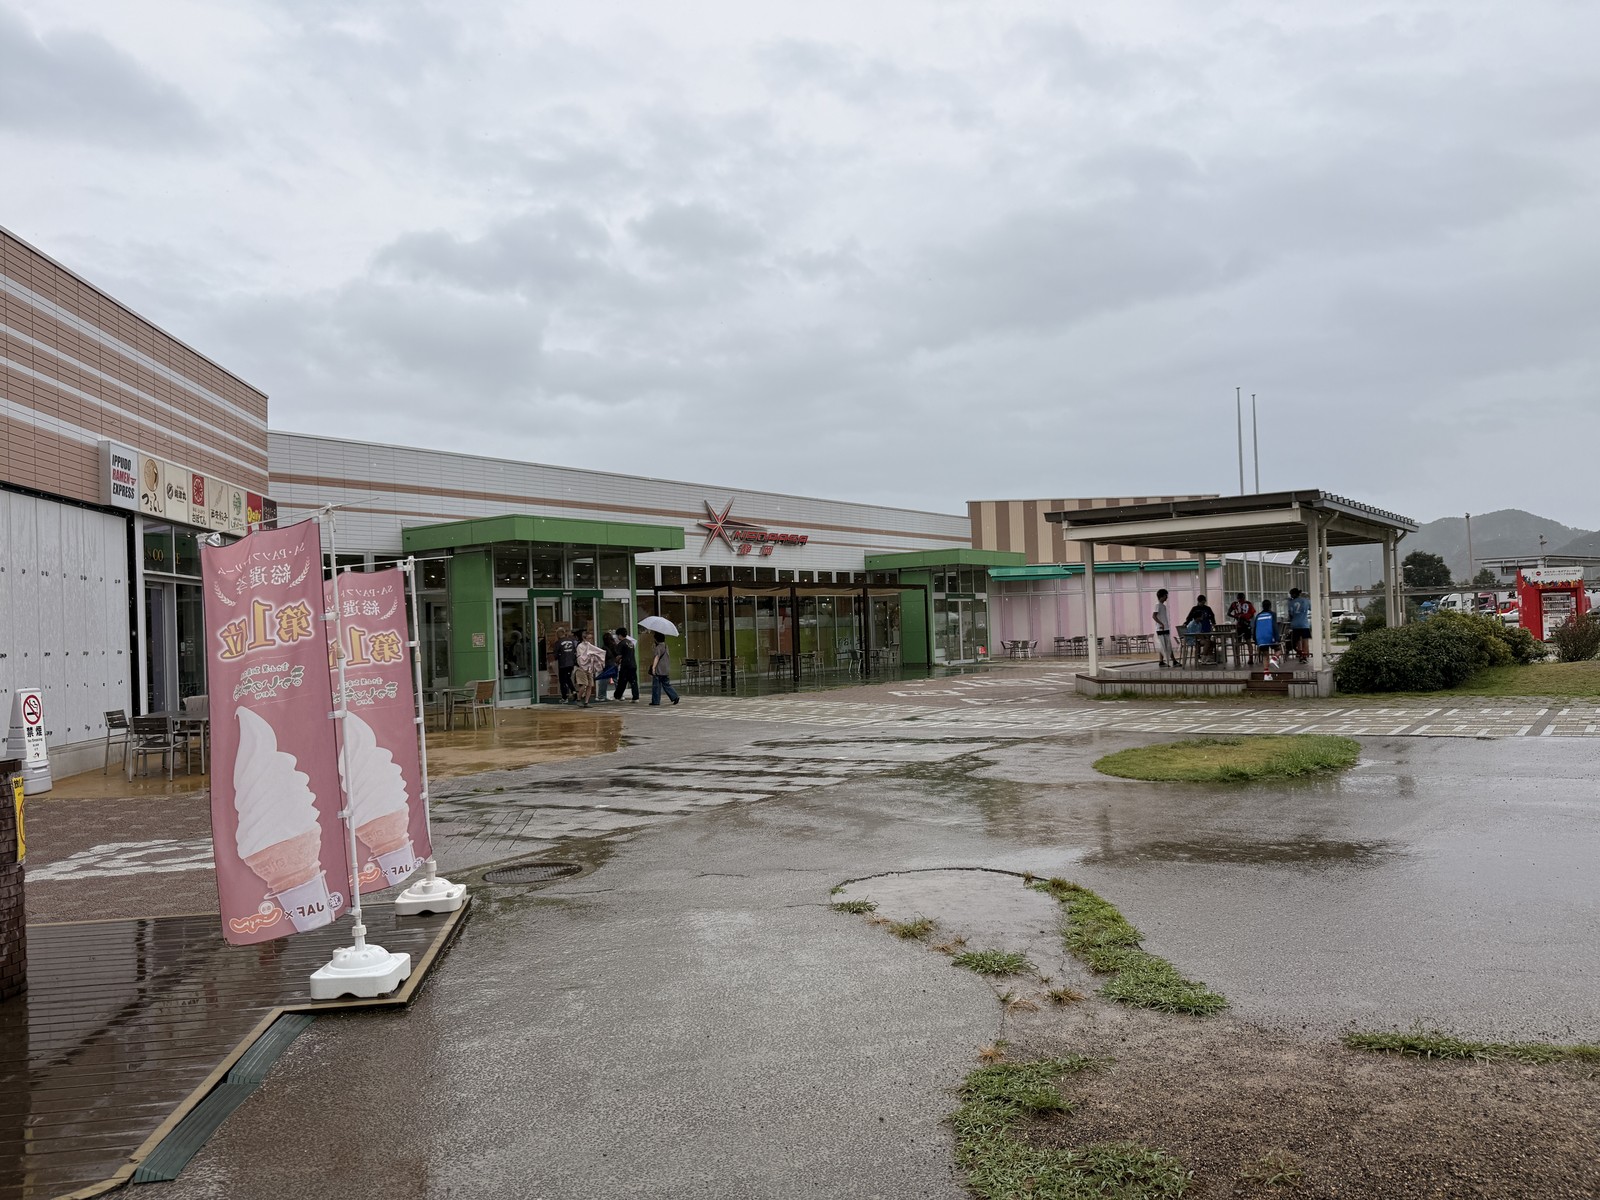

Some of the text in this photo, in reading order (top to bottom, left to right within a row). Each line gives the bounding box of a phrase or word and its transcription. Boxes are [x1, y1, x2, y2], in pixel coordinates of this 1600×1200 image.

[111, 454, 132, 471] IPPUDO
[112, 468, 131, 485] RAMEN
[112, 482, 135, 500] EXPRESS
[26, 725, 43, 738] 禁煙
